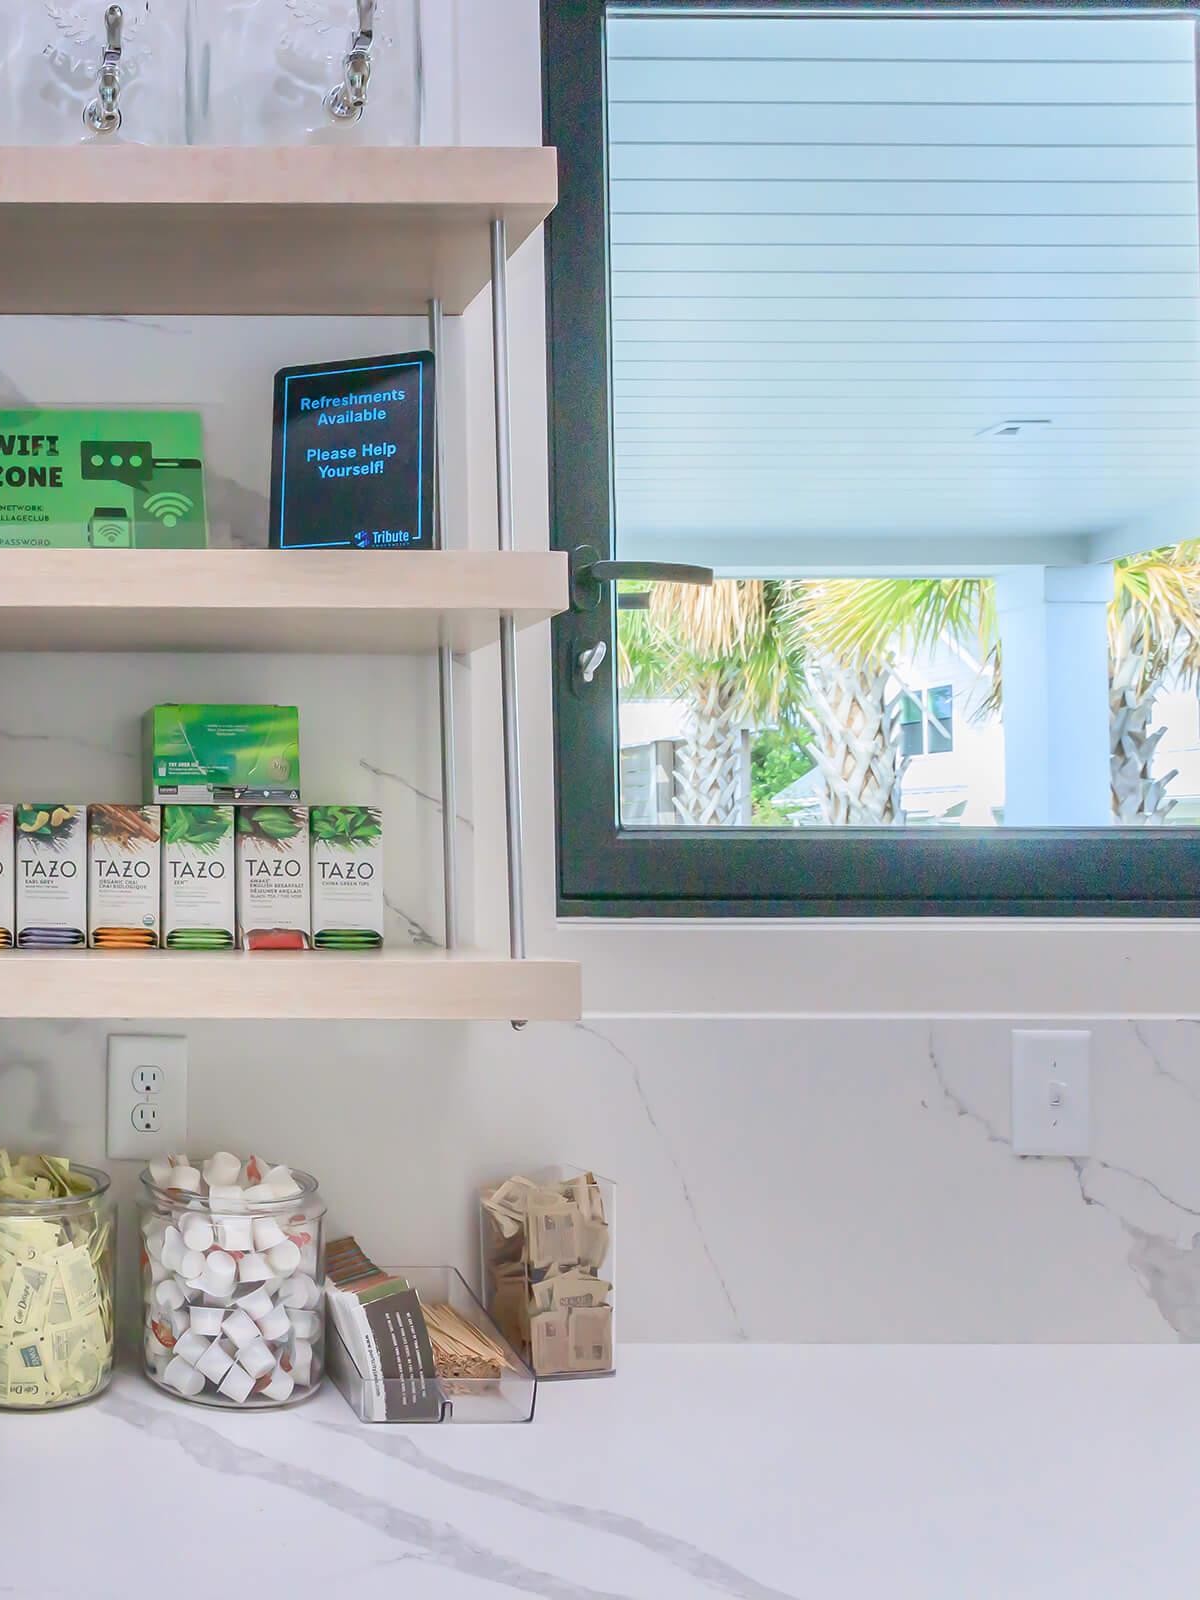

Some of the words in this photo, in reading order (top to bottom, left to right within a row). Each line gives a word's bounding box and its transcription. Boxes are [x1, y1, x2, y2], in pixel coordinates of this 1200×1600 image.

[300, 388, 406, 411] Refreshments
[317, 407, 387, 426] Available
[306, 447, 356, 462] Please
[362, 442, 397, 459] Help
[318, 460, 384, 479] Yourself!
[372, 530, 409, 544] Tribute
[21, 860, 77, 878] TAZO
[94, 860, 150, 878] TAZO
[168, 861, 225, 879] TAZO
[245, 859, 301, 877] TAZO
[317, 862, 373, 880] TAZO
